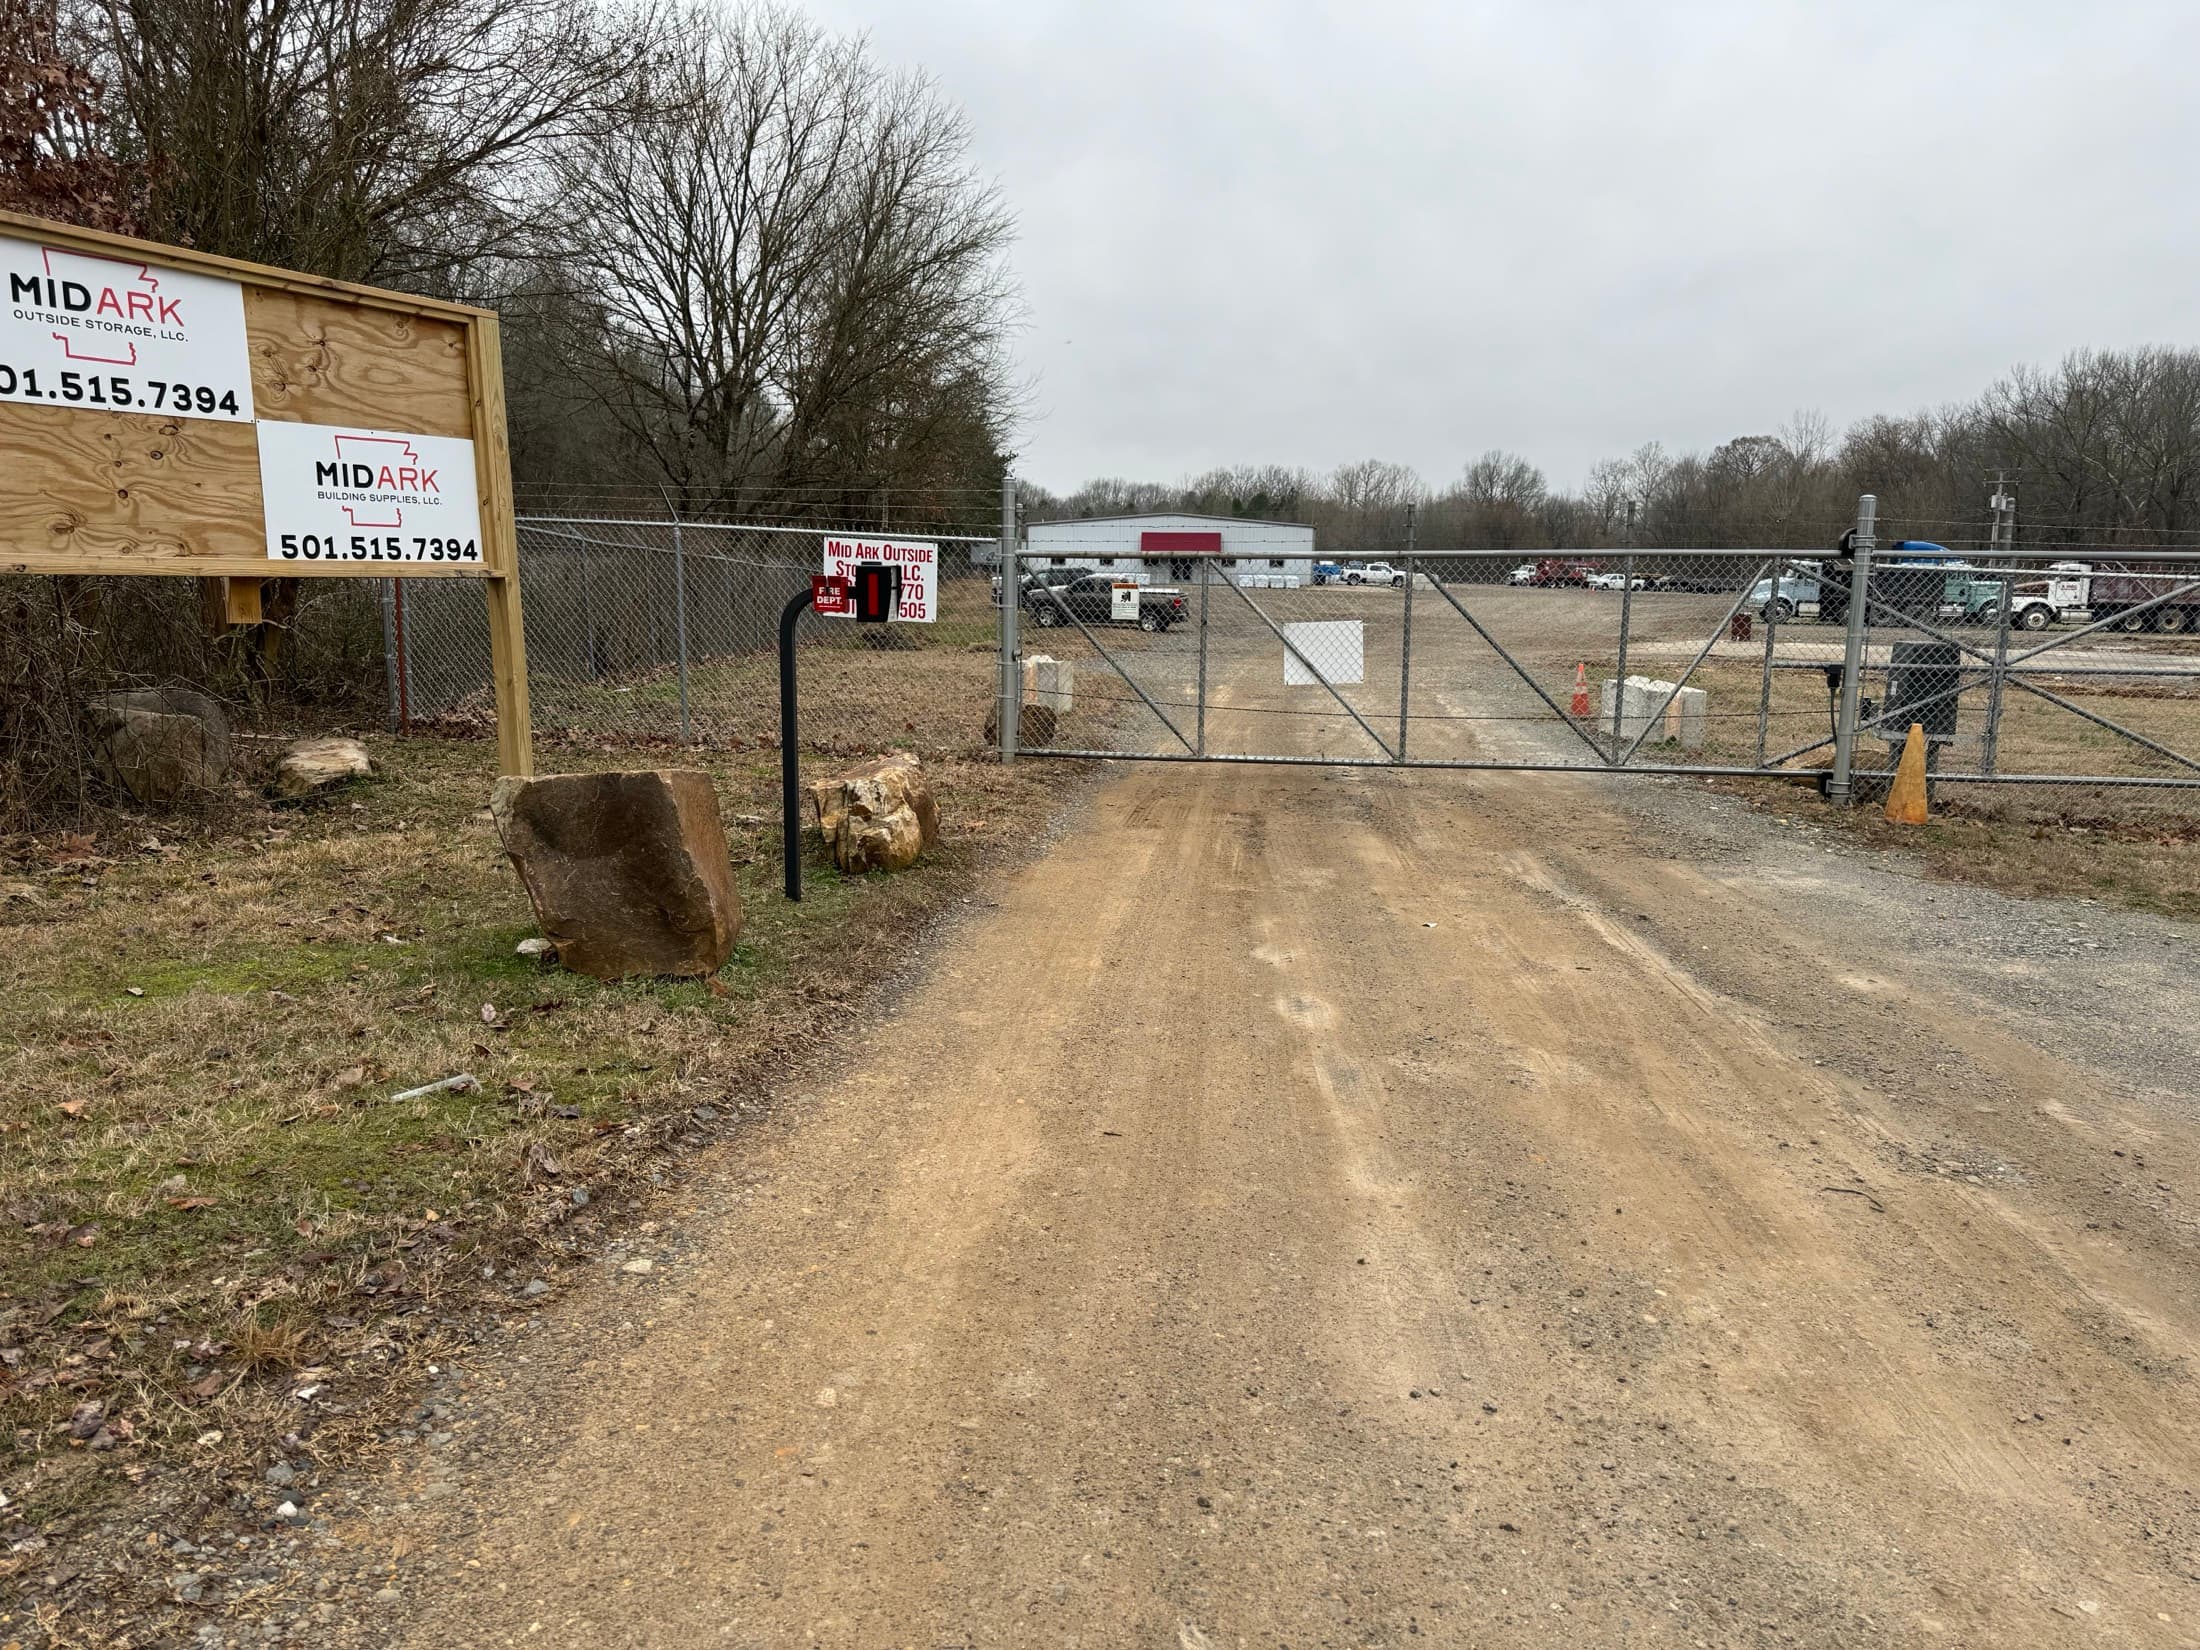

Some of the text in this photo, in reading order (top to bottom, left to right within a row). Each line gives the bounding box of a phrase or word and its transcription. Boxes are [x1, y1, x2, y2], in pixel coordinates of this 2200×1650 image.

[10, 272, 184, 327] MIDARK
[13, 309, 189, 342] OUTSIDE STORAGE, LLC.
[316, 461, 440, 493] MIDARK
[317, 491, 367, 502] BUILDING
[423, 497, 443, 506] LLC.
[281, 534, 478, 561] 501.515.7394
[900, 564, 924, 581] LC.
[818, 586, 841, 596] FRE
